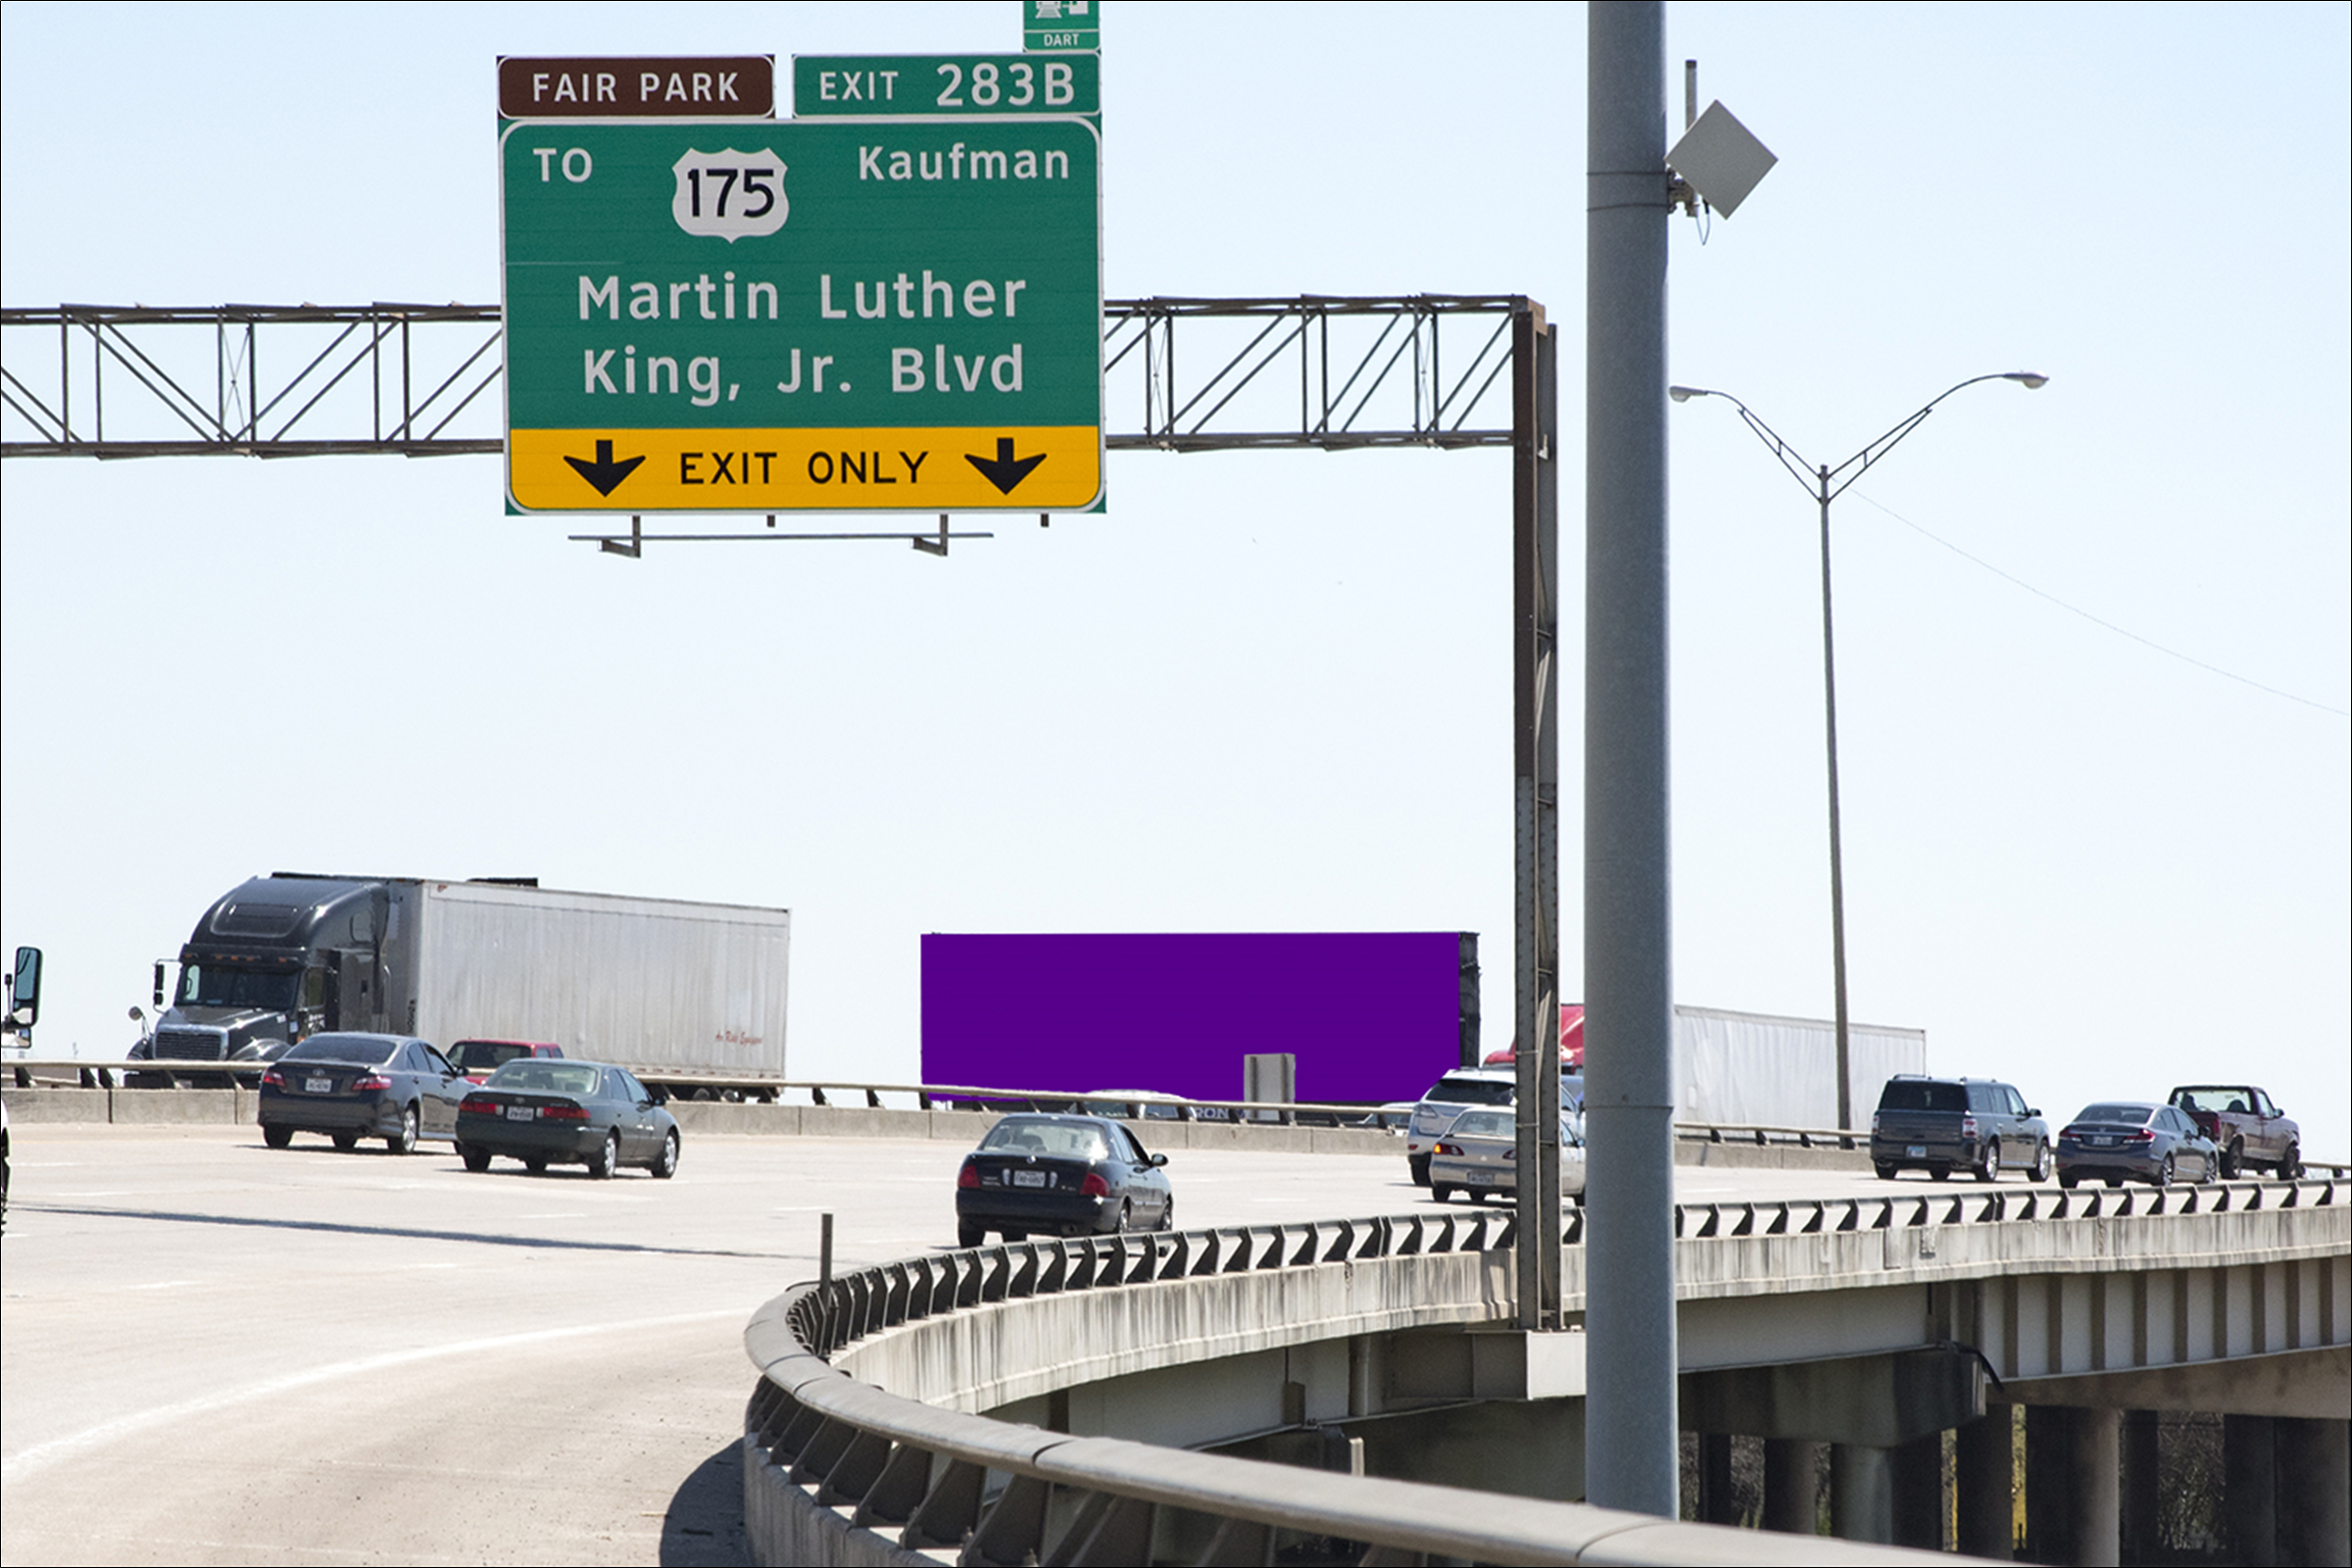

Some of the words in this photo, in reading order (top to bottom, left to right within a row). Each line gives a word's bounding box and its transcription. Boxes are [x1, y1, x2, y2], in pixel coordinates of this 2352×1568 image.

[1044, 33, 1079, 47] DART
[533, 73, 616, 102] FAIR
[640, 72, 739, 102] PARK
[820, 71, 899, 100] EXIT
[937, 63, 1074, 106] 283B
[532, 148, 592, 182] TO
[859, 142, 1069, 180] Kaufman
[687, 168, 775, 219] 175
[579, 270, 778, 320] Martin
[820, 270, 1026, 318] Luther
[584, 345, 740, 407] King,
[777, 348, 852, 393] Jr.
[892, 343, 1023, 392] Blvd
[680, 452, 778, 485] EXIT
[808, 451, 929, 484] ONLY
